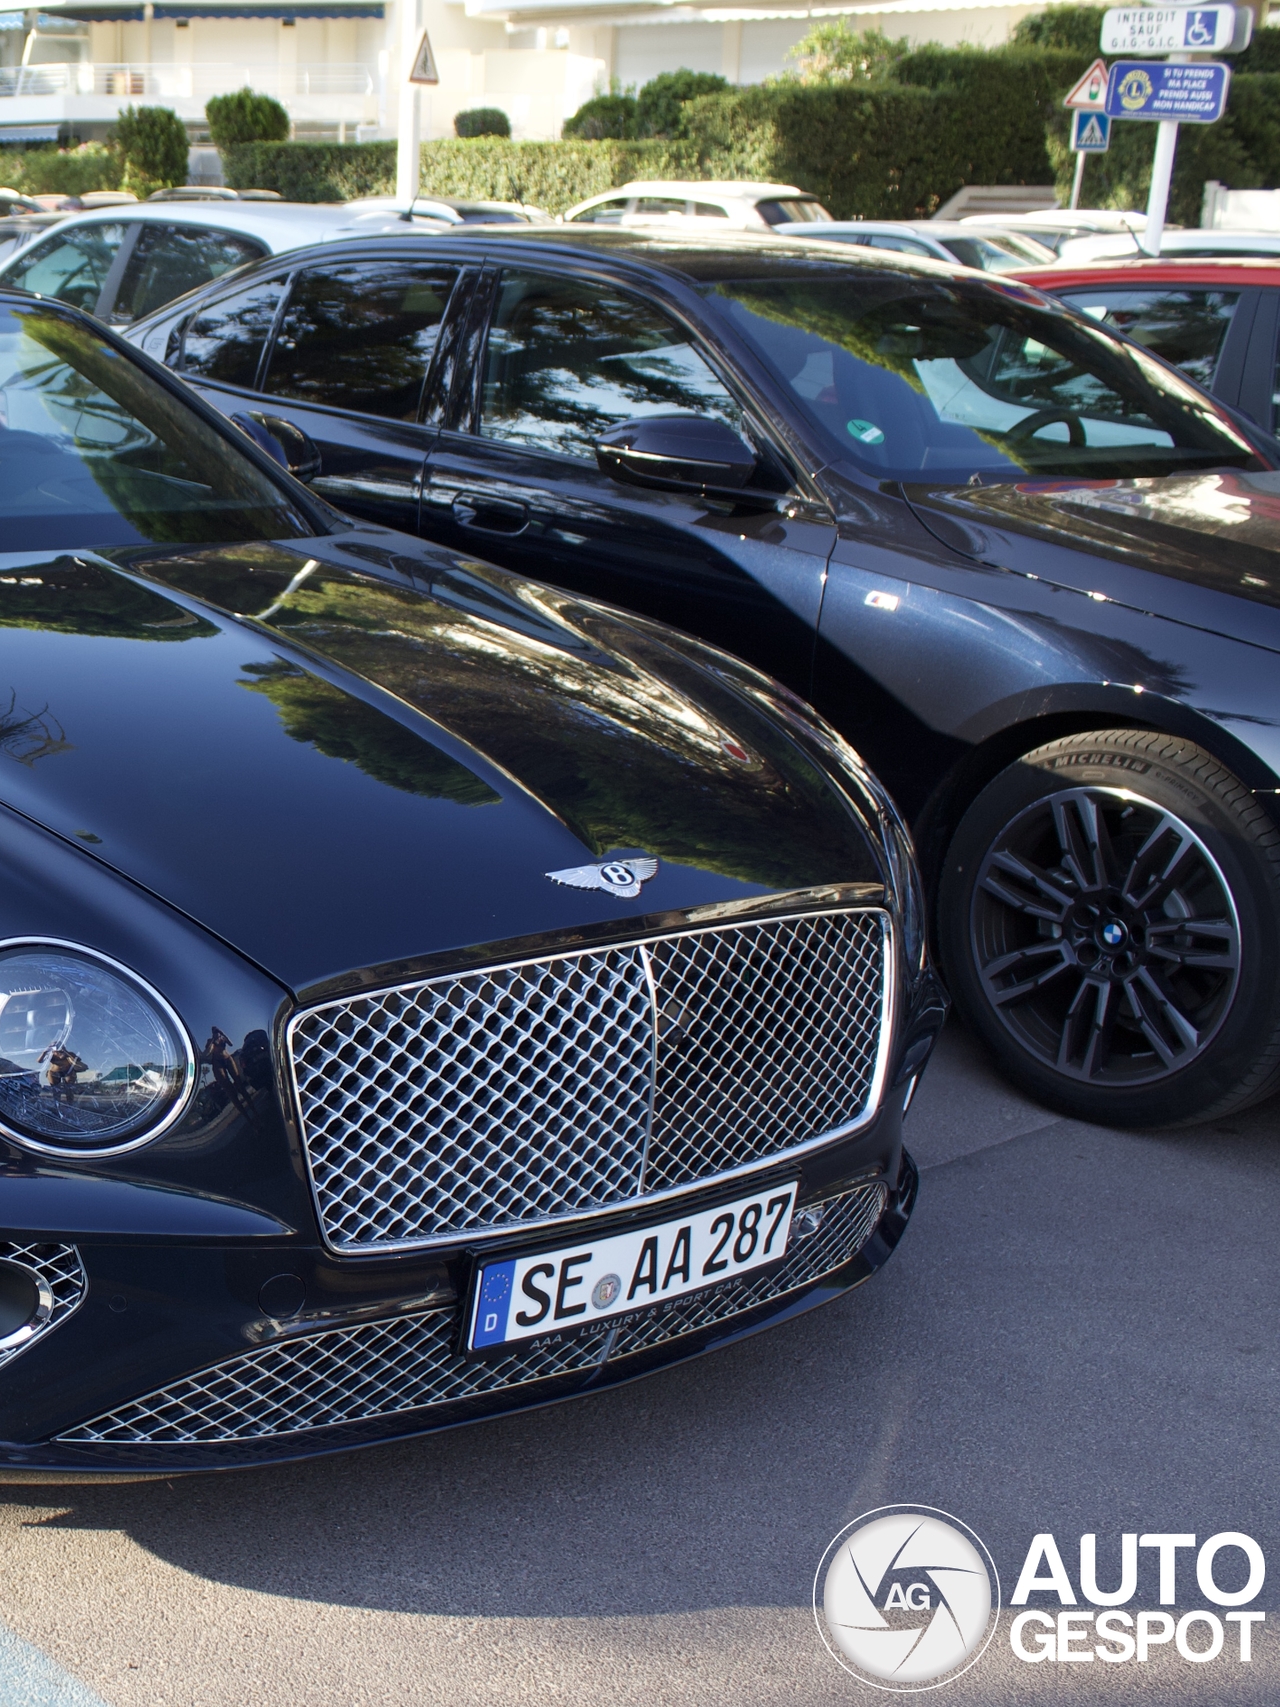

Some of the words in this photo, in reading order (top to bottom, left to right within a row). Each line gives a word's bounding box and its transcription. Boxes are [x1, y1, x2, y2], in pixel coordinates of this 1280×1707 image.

[1117, 11, 1177, 23] INTERDIT
[1130, 24, 1162, 36] SAUF
[1184, 69, 1215, 79] PRENDS
[1182, 79, 1207, 89] PLACE
[1158, 89, 1188, 100] PRENDS
[1189, 91, 1213, 101] AUSSI
[1152, 100, 1173, 111] MON
[1174, 101, 1216, 112] HANDICAP
[1055, 753, 1147, 771] MICHELIN
[516, 1252, 592, 1327] SE
[627, 1226, 691, 1300] AA
[702, 1192, 793, 1276] 287
[529, 1335, 562, 1350] AAA
[580, 1311, 644, 1336] LUXURY
[647, 1308, 657, 1318] &
[663, 1291, 712, 1313] SPORT
[714, 1278, 743, 1294] CAR
[484, 1313, 498, 1333] D
